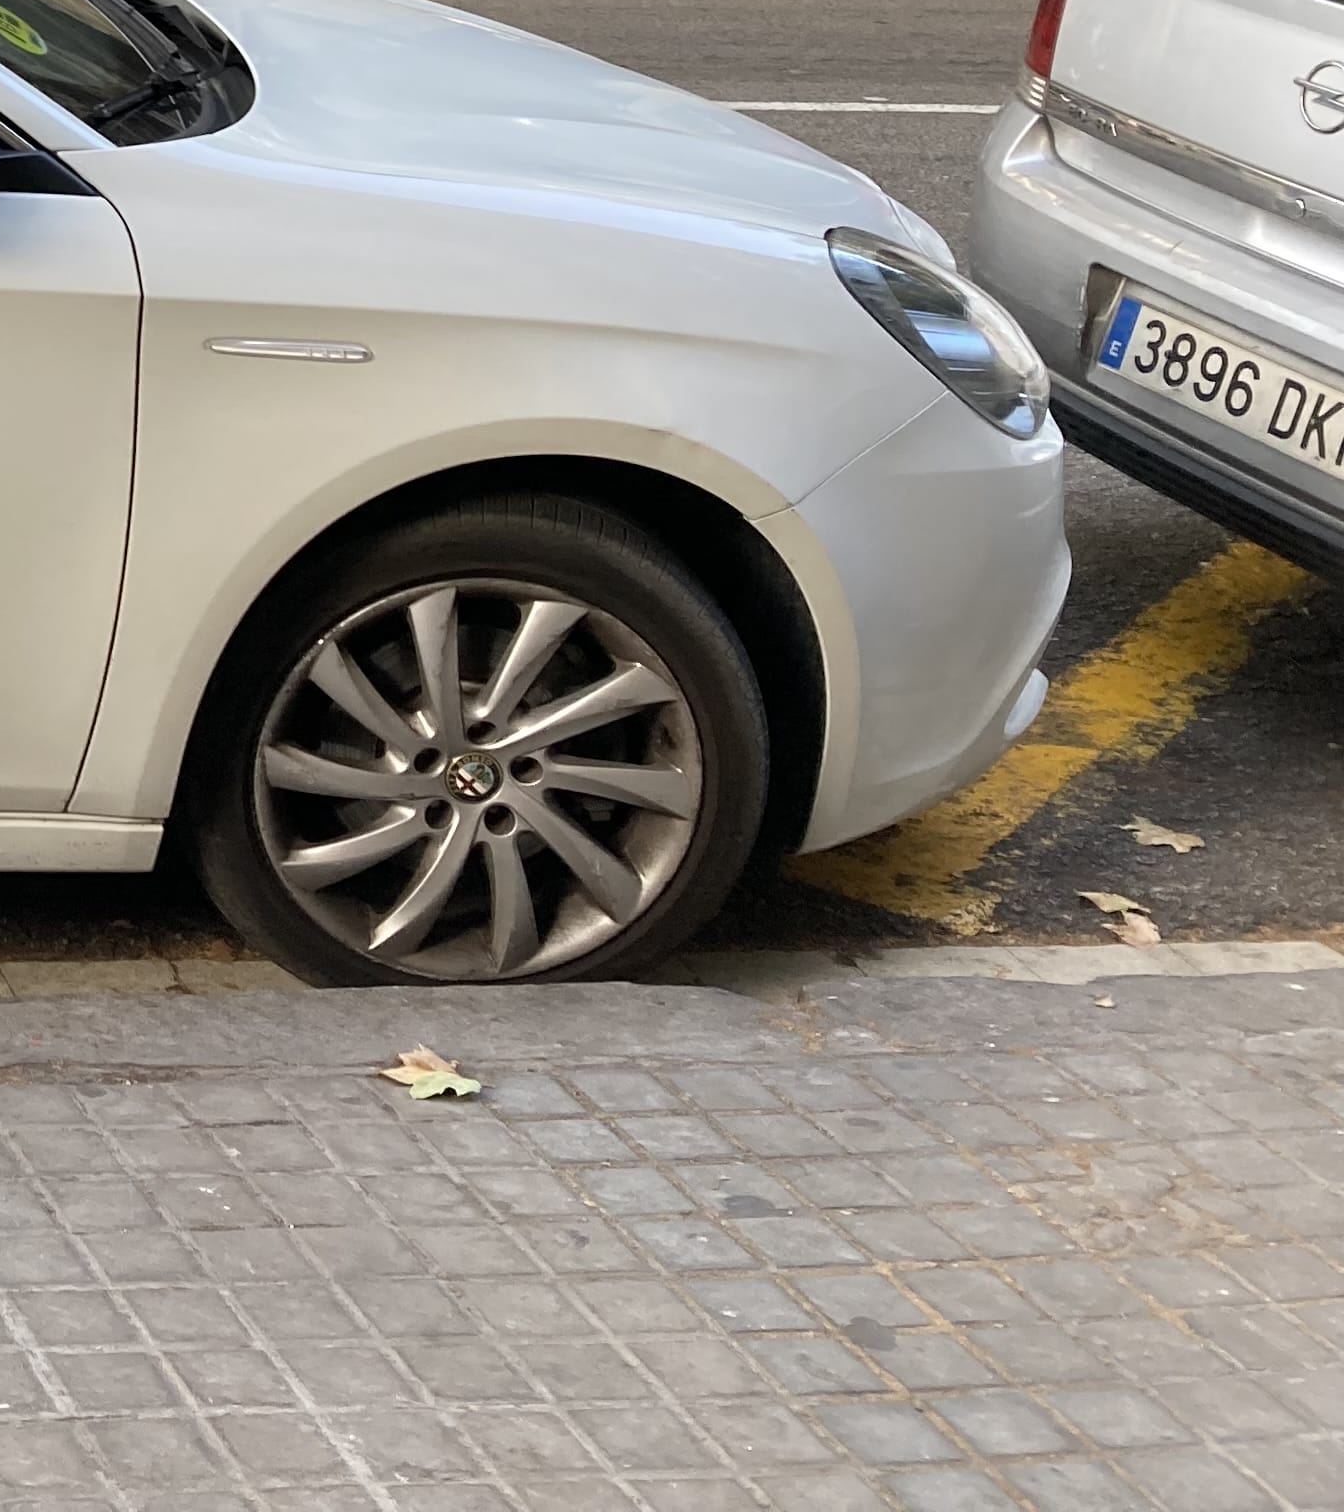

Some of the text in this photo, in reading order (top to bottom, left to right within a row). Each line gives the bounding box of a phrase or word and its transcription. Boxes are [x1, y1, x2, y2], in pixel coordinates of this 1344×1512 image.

[1109, 340, 1121, 357] E
[1134, 319, 1344, 466] 3896 DK
